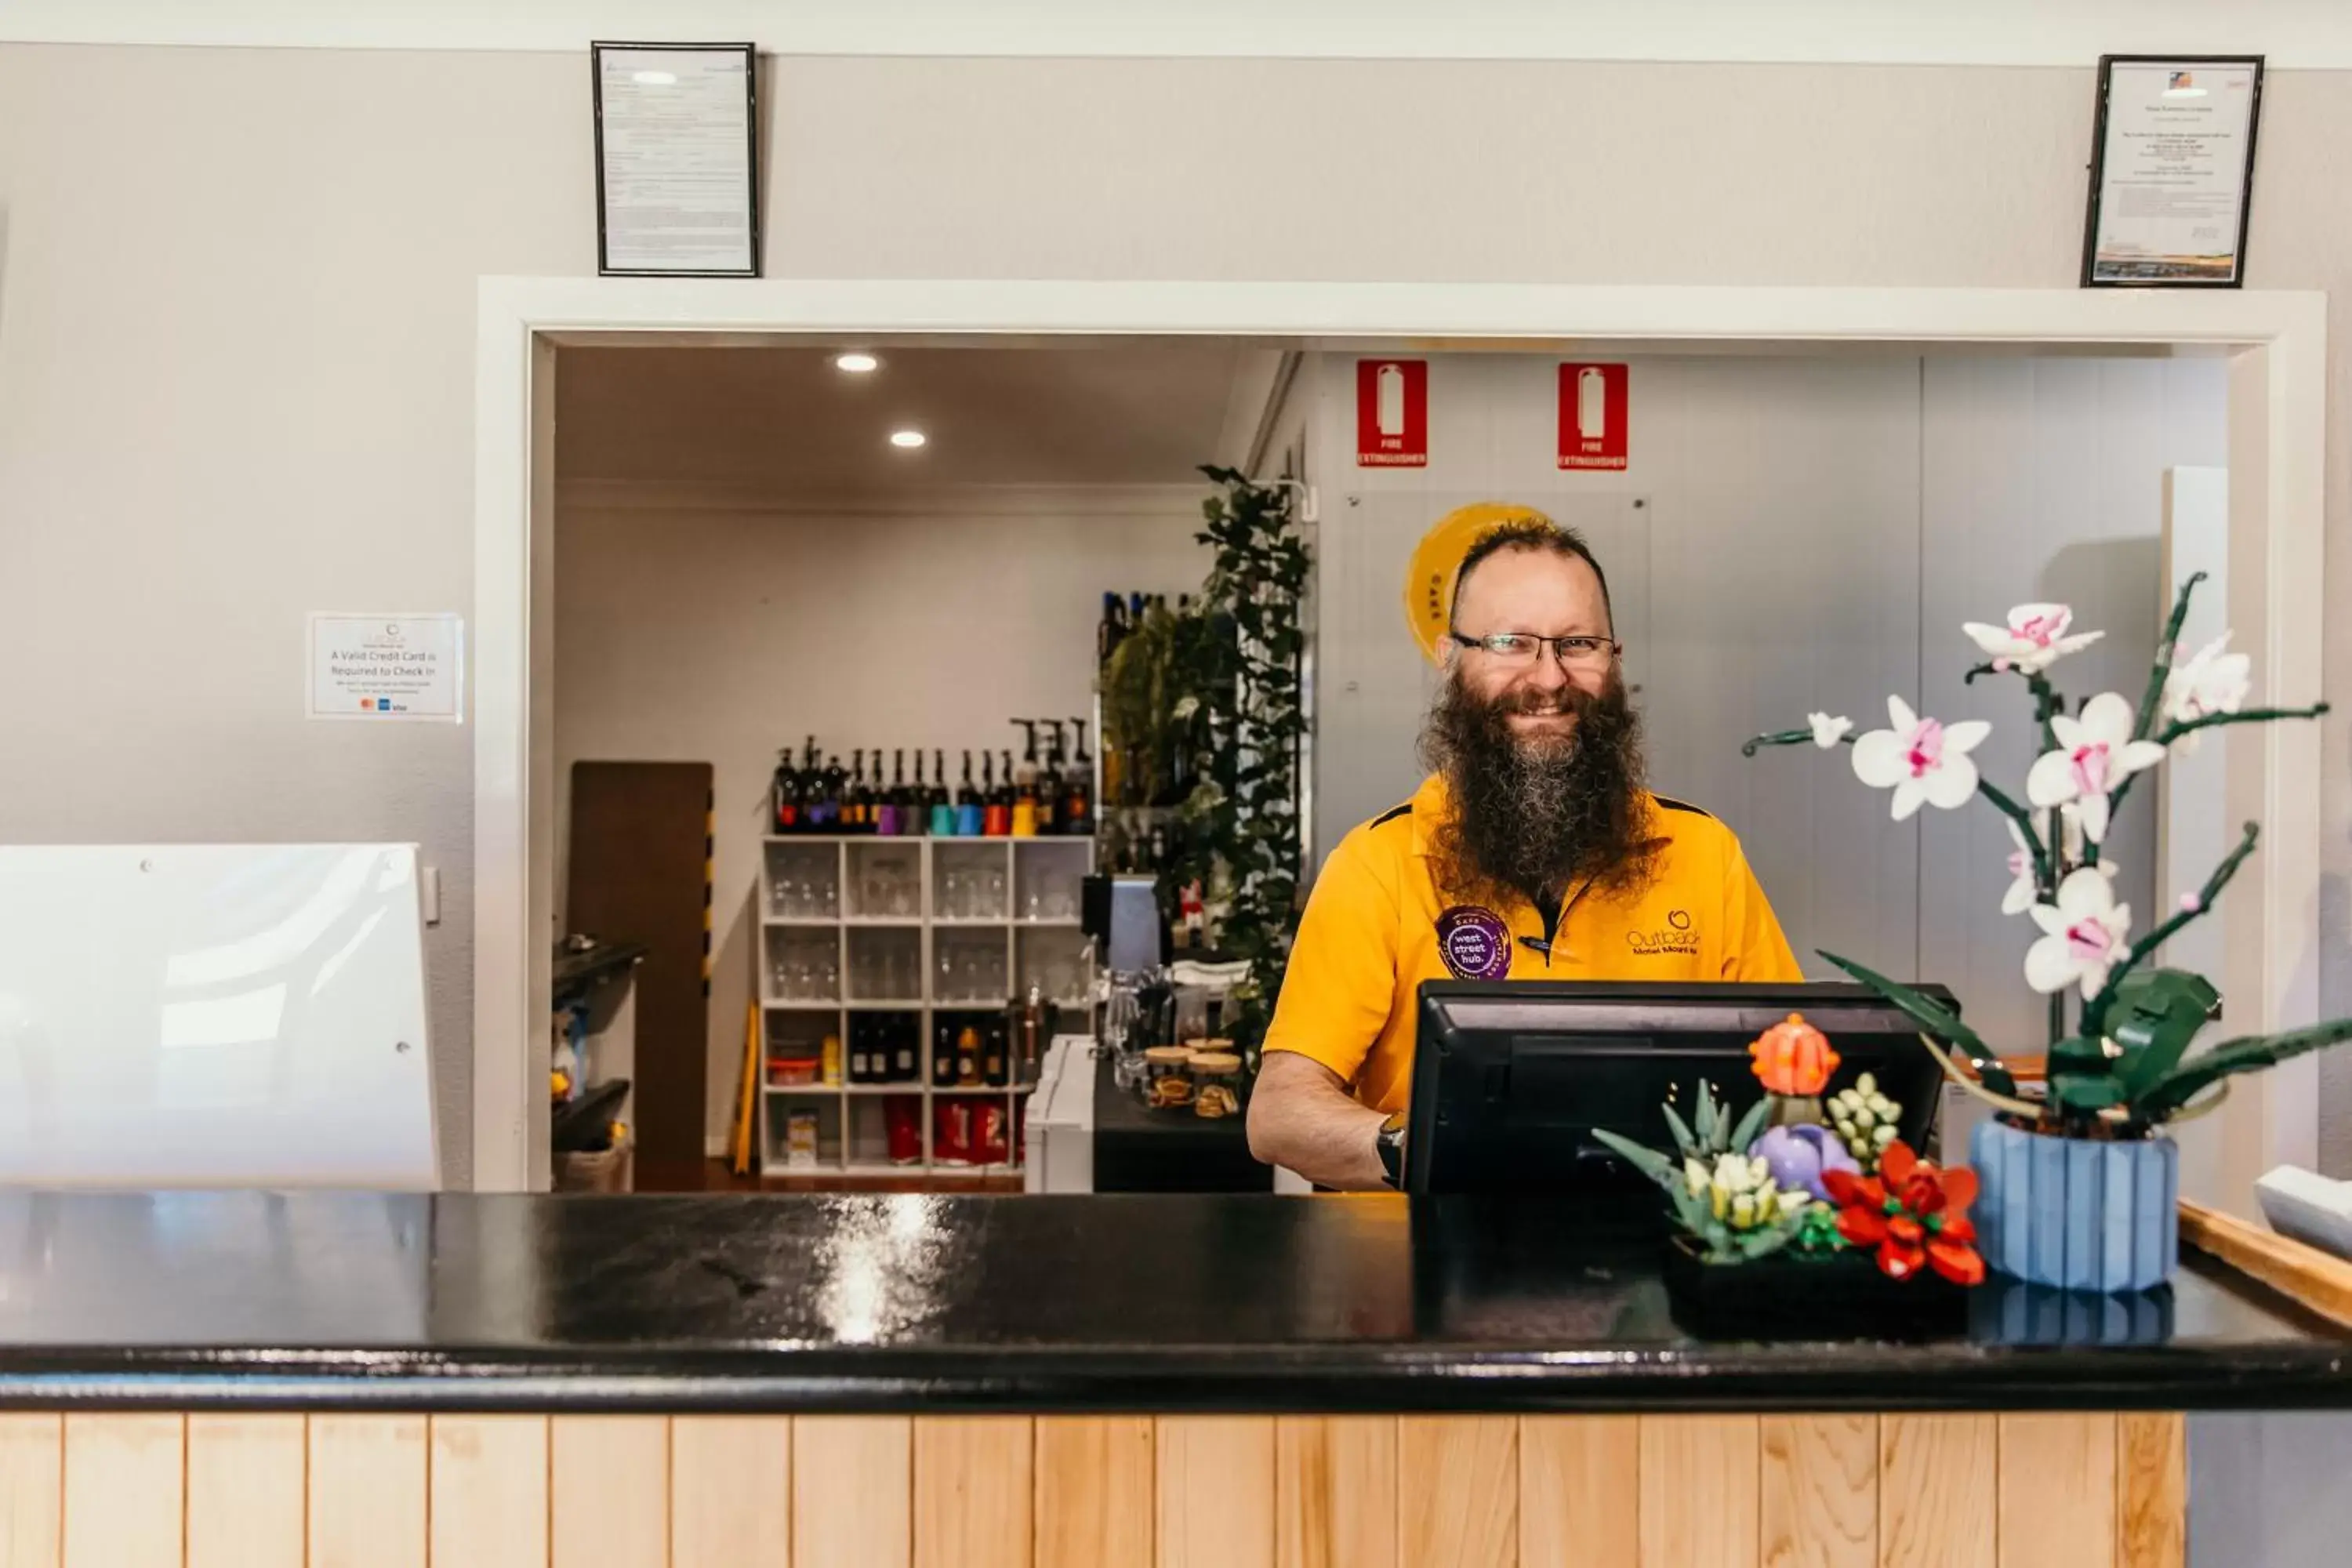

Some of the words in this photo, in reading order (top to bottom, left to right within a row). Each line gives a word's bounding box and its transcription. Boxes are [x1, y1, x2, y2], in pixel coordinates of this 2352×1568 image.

[1381, 439, 1402, 449] FIRE
[1581, 441, 1602, 452] FIRE
[1357, 453, 1426, 464] EXTINGUISHER
[1558, 456, 1627, 467] EXTINGUISHER
[341, 652, 366, 660] Valid
[369, 652, 399, 661] Credit
[402, 652, 426, 661] Card
[332, 666, 376, 676] Required
[380, 666, 391, 676] to
[394, 666, 423, 676] Check
[1455, 934, 1482, 942] west
[1454, 944, 1487, 954] street
[1662, 946, 1688, 954] Mount
[1461, 954, 1485, 964] hub.
